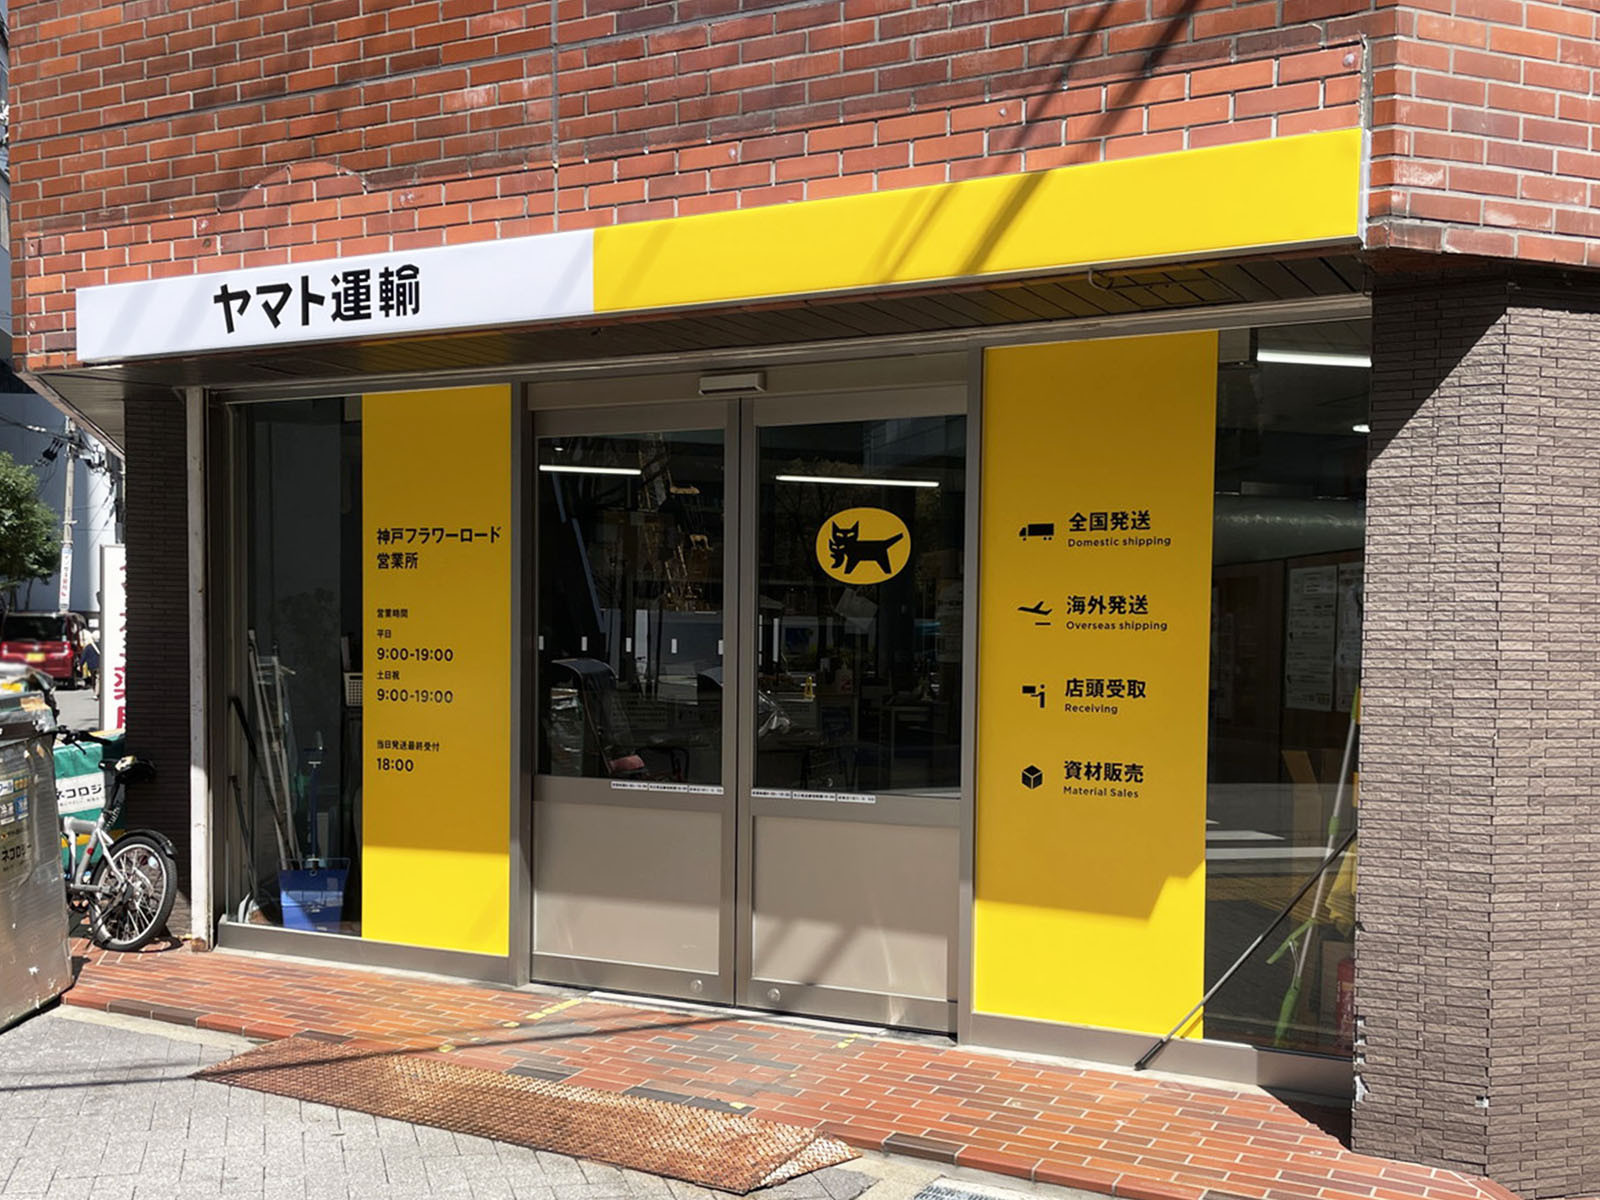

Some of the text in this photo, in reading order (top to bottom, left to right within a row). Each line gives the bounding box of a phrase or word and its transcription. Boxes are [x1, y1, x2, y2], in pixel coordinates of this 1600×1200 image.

[213, 263, 421, 334] ヤマト運輸
[1068, 510, 1151, 532] 全国発送
[376, 525, 502, 545] 神戸フラワーロード
[1067, 535, 1171, 548] Domestic shipping
[376, 551, 419, 569] 営業所
[1066, 594, 1149, 616] 海外発送
[376, 608, 409, 619] 営業時間
[376, 628, 392, 639] 平日
[1066, 620, 1168, 632] Overseas shipping
[376, 647, 454, 662] 9:00-19:00
[376, 670, 401, 681] 土日祝
[1064, 677, 1147, 699] 店頭受取
[376, 688, 454, 704] 9:00-19:00
[1064, 703, 1119, 715] Receiving
[376, 739, 440, 752] 当日発送最終受付
[376, 757, 415, 772] 18:00
[1063, 760, 1144, 783] 資材販売
[1063, 785, 1139, 799] Material Sales
